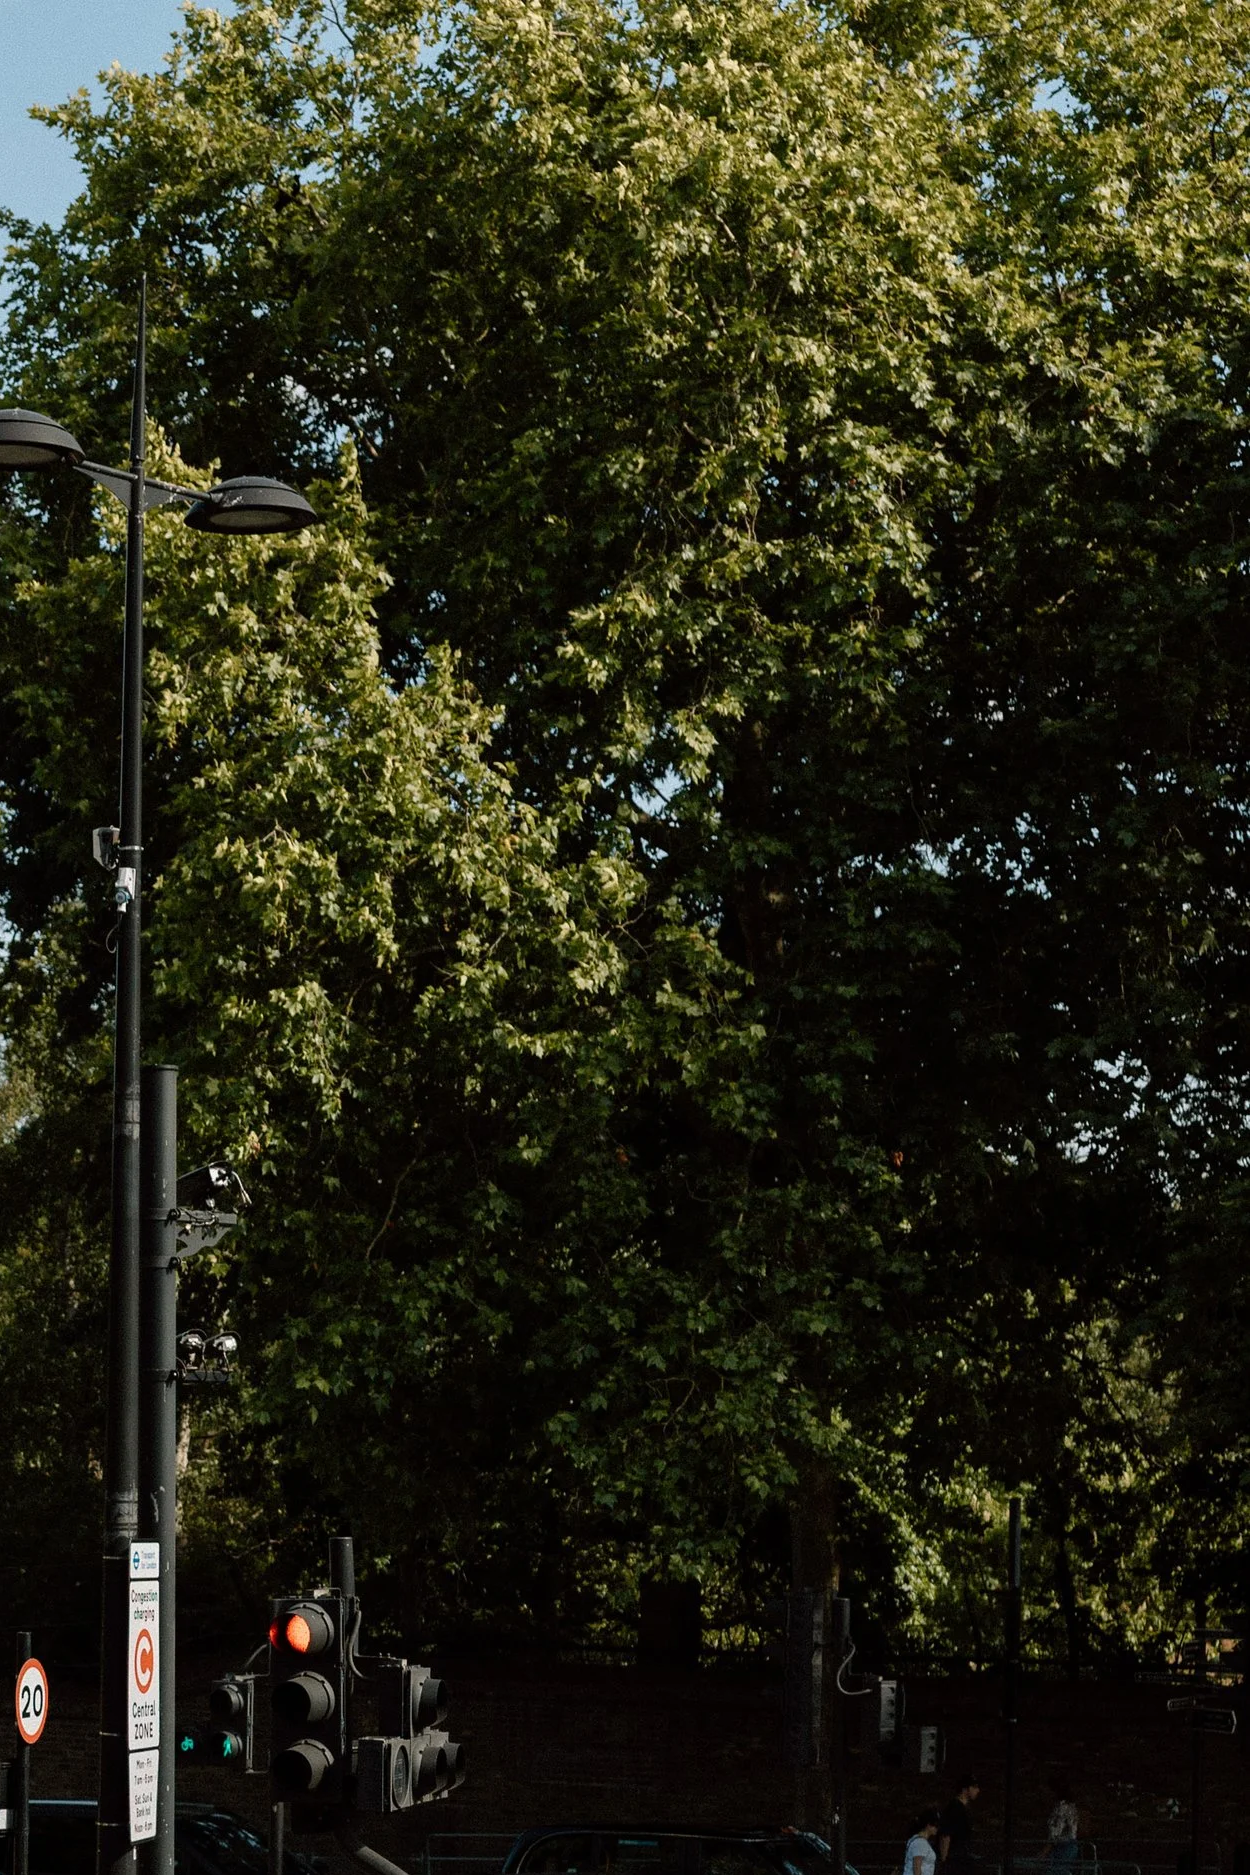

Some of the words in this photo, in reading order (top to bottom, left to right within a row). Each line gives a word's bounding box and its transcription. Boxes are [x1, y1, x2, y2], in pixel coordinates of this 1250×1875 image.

[131, 1589, 158, 1605] Congestion
[134, 1606, 155, 1622] charging
[21, 1684, 43, 1718] 20
[132, 1700, 156, 1718] Central
[134, 1722, 154, 1740] ZONE
